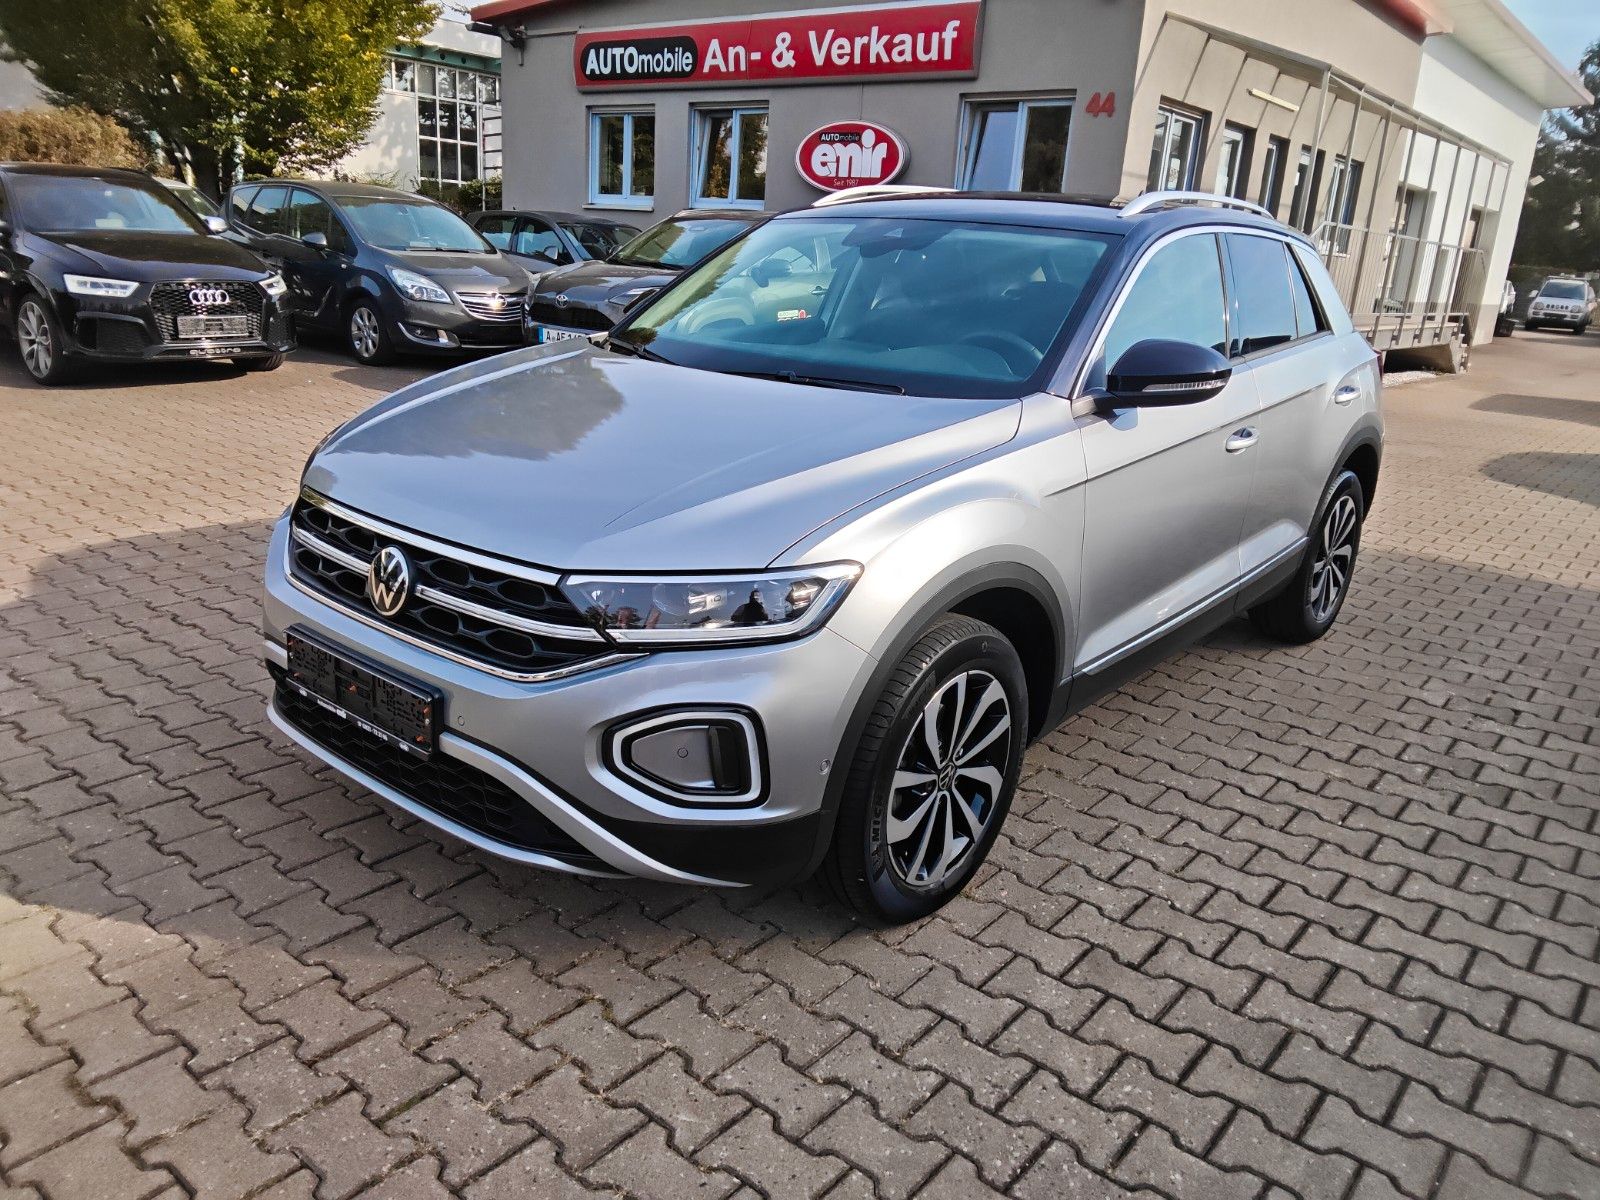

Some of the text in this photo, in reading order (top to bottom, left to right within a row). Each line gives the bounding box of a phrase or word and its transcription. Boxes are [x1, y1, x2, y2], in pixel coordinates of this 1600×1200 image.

[586, 19, 960, 75] AUTOmobile An- & Verkauf
[1085, 91, 1116, 118] 44
[821, 133, 860, 141] AUTOmobile
[811, 128, 887, 178] emir
[833, 178, 859, 187] Seit 1987
[189, 347, 241, 356] quattro
